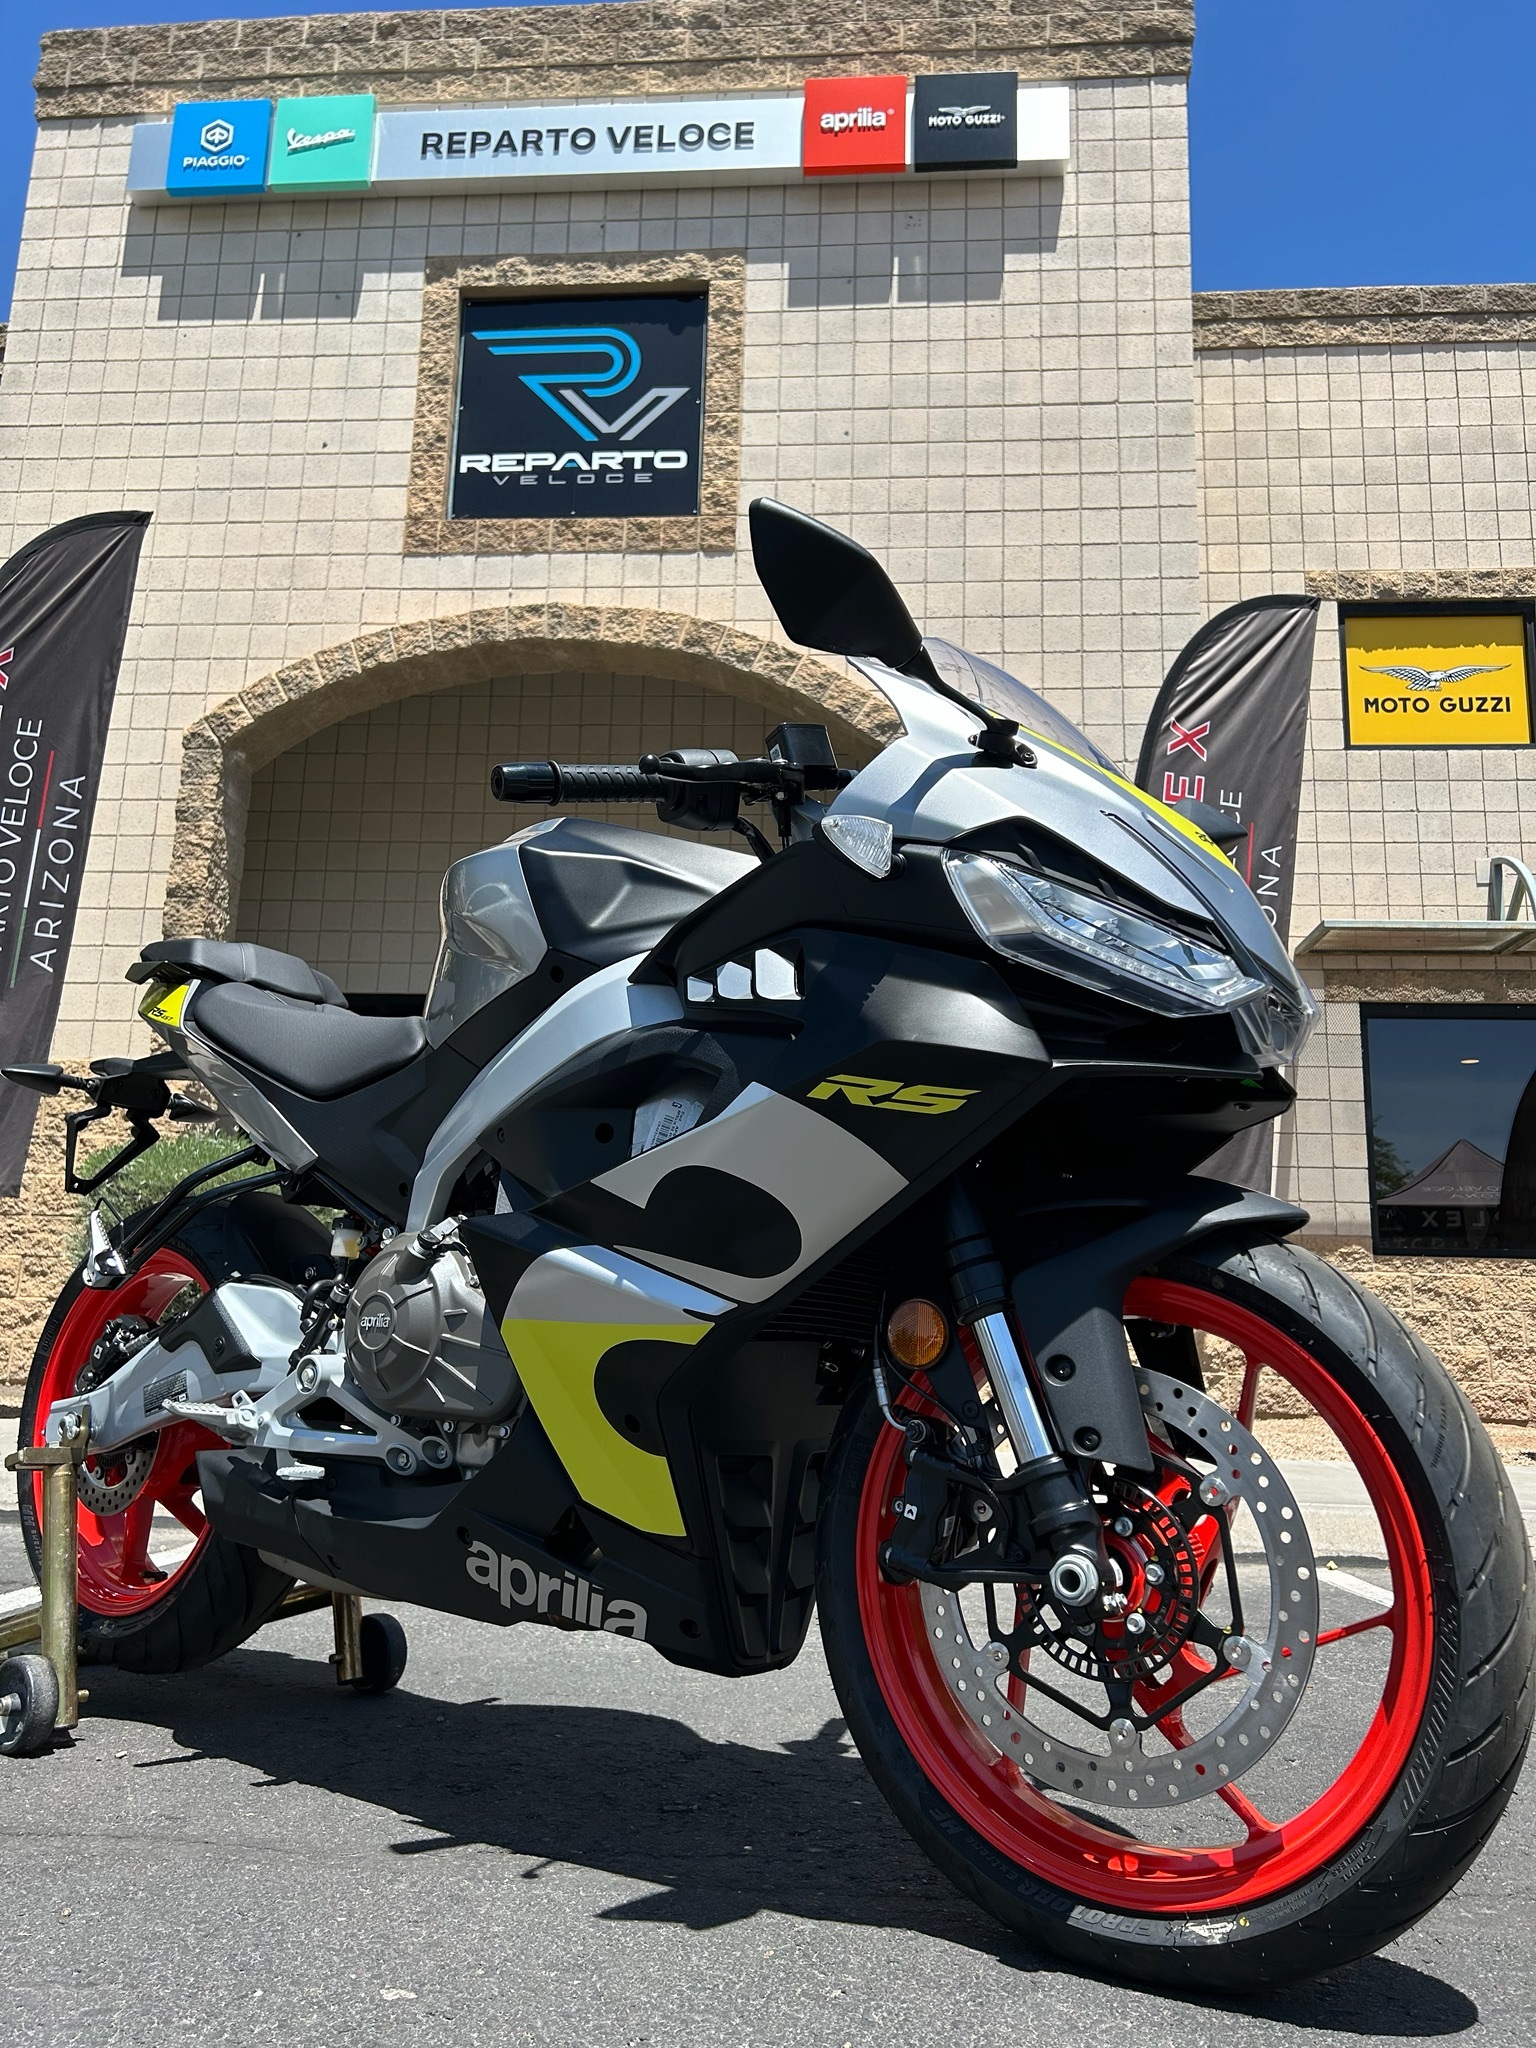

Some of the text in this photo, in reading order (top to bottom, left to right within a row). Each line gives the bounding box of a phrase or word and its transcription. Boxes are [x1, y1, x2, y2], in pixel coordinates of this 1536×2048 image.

[820, 107, 888, 132] aprilia
[928, 113, 1001, 127] MOTO GUZZI
[286, 127, 356, 152] Vespa
[421, 121, 755, 157] REPARTO VELOCE
[182, 155, 246, 169] PIAGGIO
[459, 449, 689, 474] REPARTO
[493, 473, 653, 486] VELOCE
[1363, 696, 1511, 713] MOTO GUZZI
[0, 717, 43, 847] VELOCE
[30, 776, 87, 973] ARIZONA
[806, 1073, 983, 1115] RS
[360, 1312, 391, 1331] aprilia
[465, 1540, 648, 1641] aprilia
